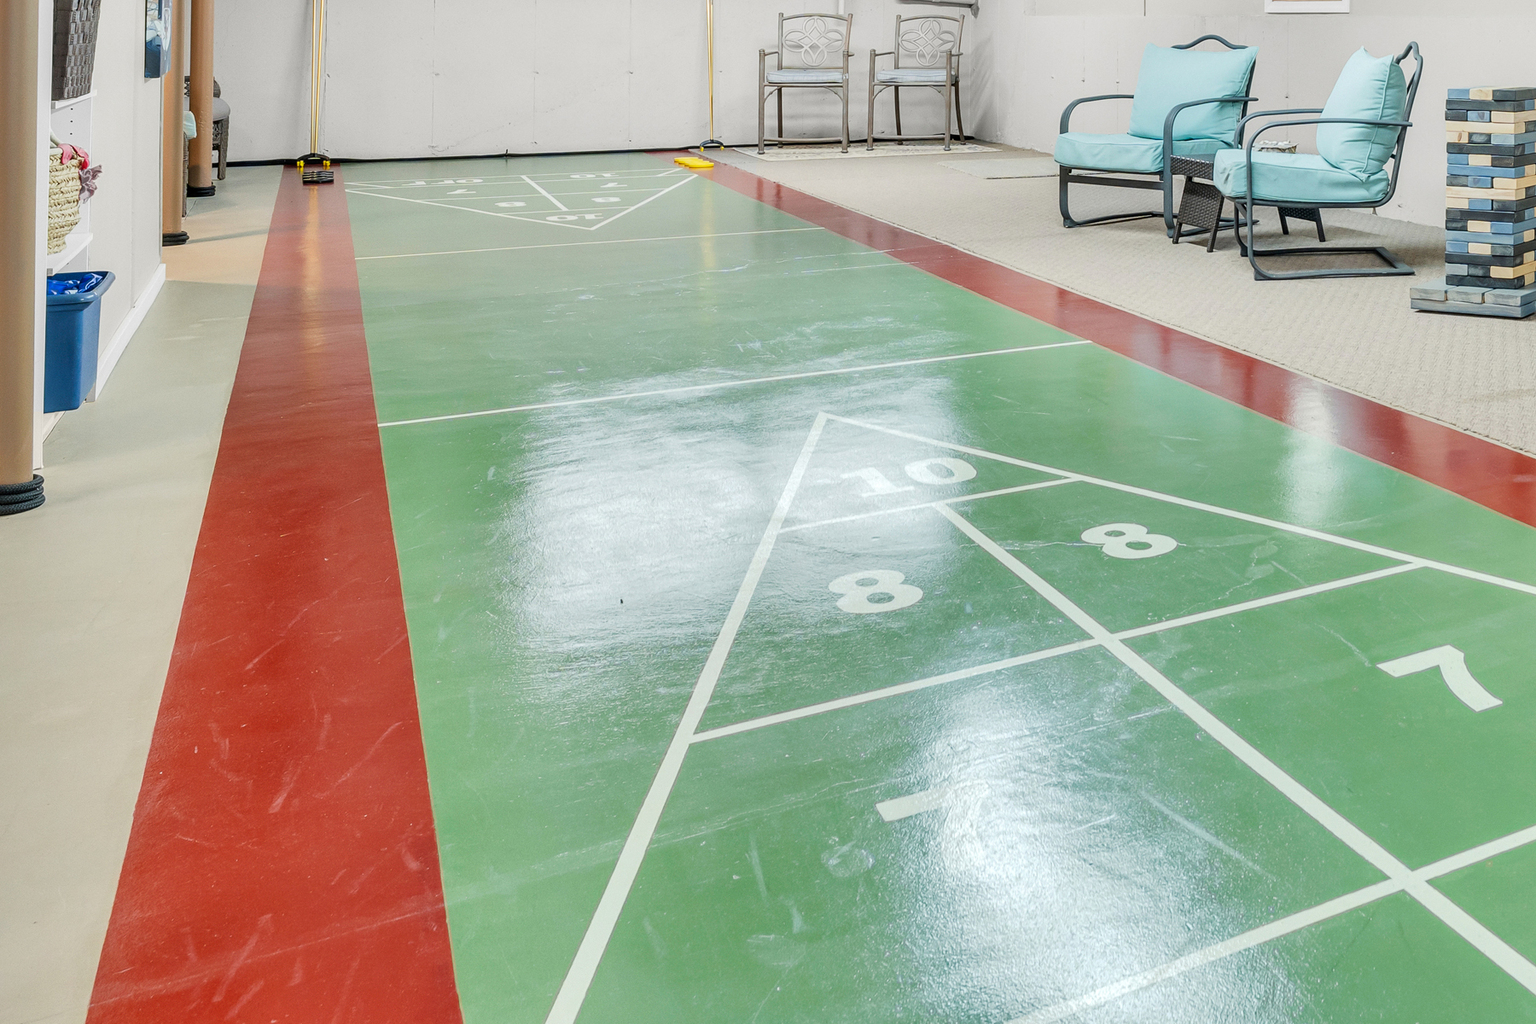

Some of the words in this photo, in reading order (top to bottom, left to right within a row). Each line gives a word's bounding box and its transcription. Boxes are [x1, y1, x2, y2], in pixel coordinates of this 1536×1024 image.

[840, 456, 979, 499] 10
[1080, 522, 1179, 560] 8
[827, 568, 925, 615] 8
[1375, 643, 1504, 714] 7
